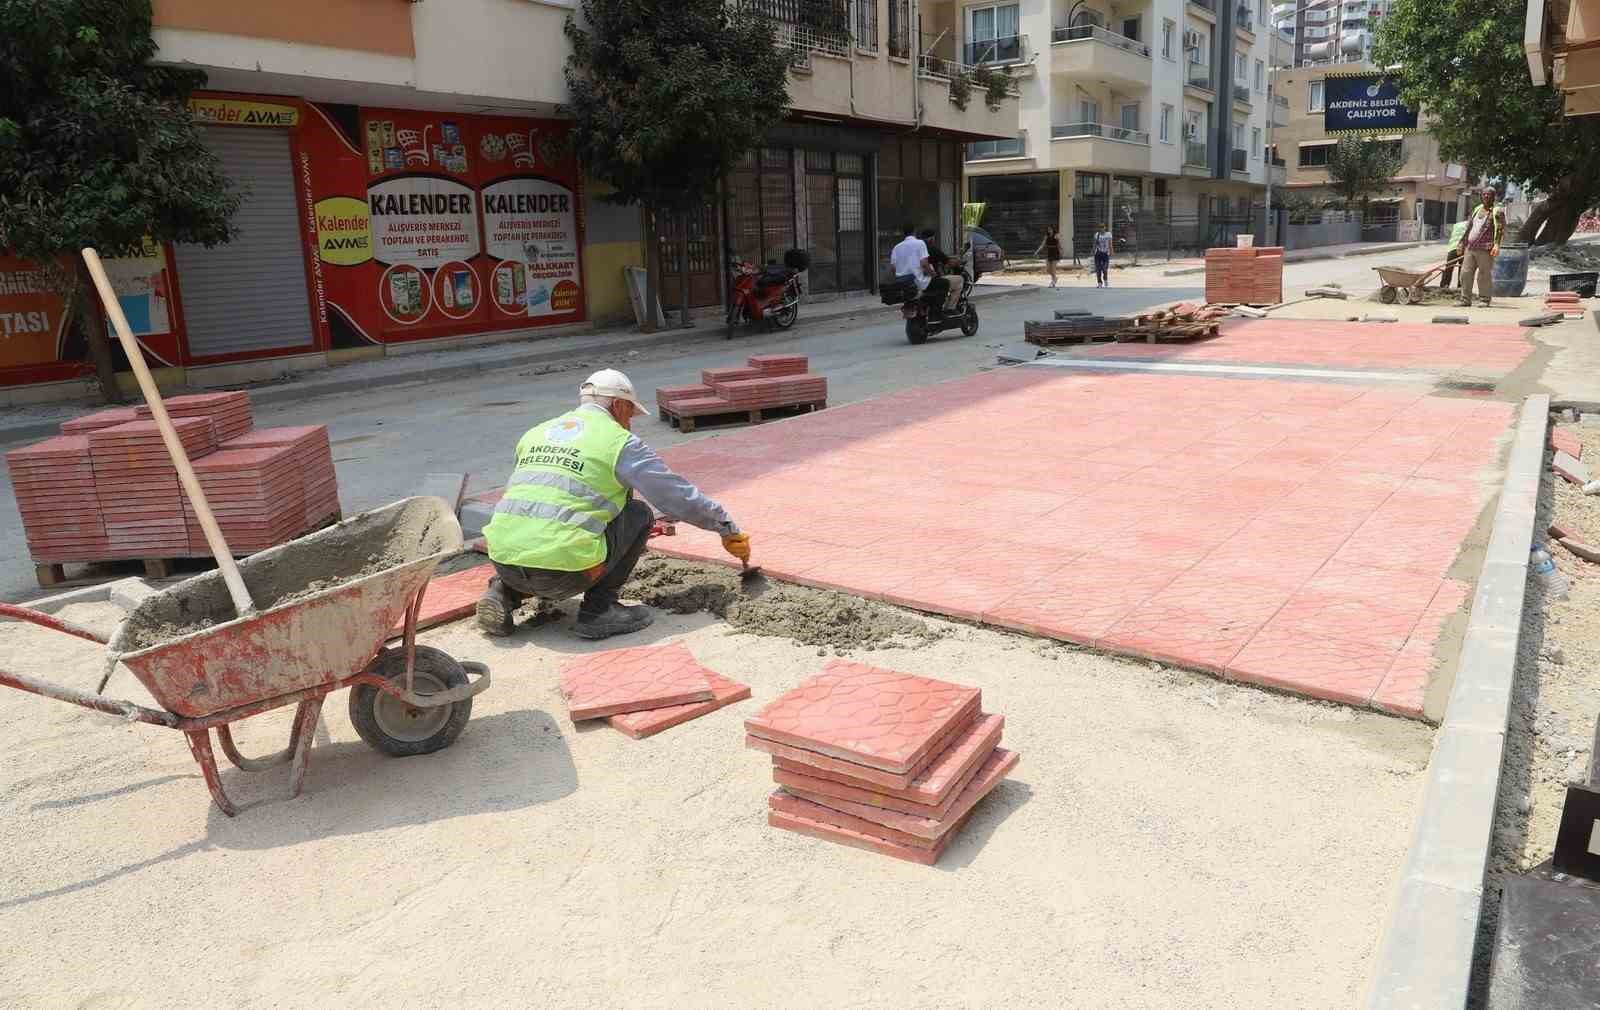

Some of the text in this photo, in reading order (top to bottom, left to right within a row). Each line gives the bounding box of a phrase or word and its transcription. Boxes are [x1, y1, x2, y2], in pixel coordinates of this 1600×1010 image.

[1329, 99, 1368, 109] AKDENİZ
[1347, 108, 1396, 120] ÇALIŞIYOR
[371, 193, 472, 215] KALENDER
[484, 194, 570, 214] KALENDER
[318, 216, 369, 232] Kalender
[382, 235, 415, 246] TOPTAN
[415, 234, 426, 245] VE
[529, 445, 581, 458] AKDENİZ
[519, 455, 585, 472] BELEDİYESİ
